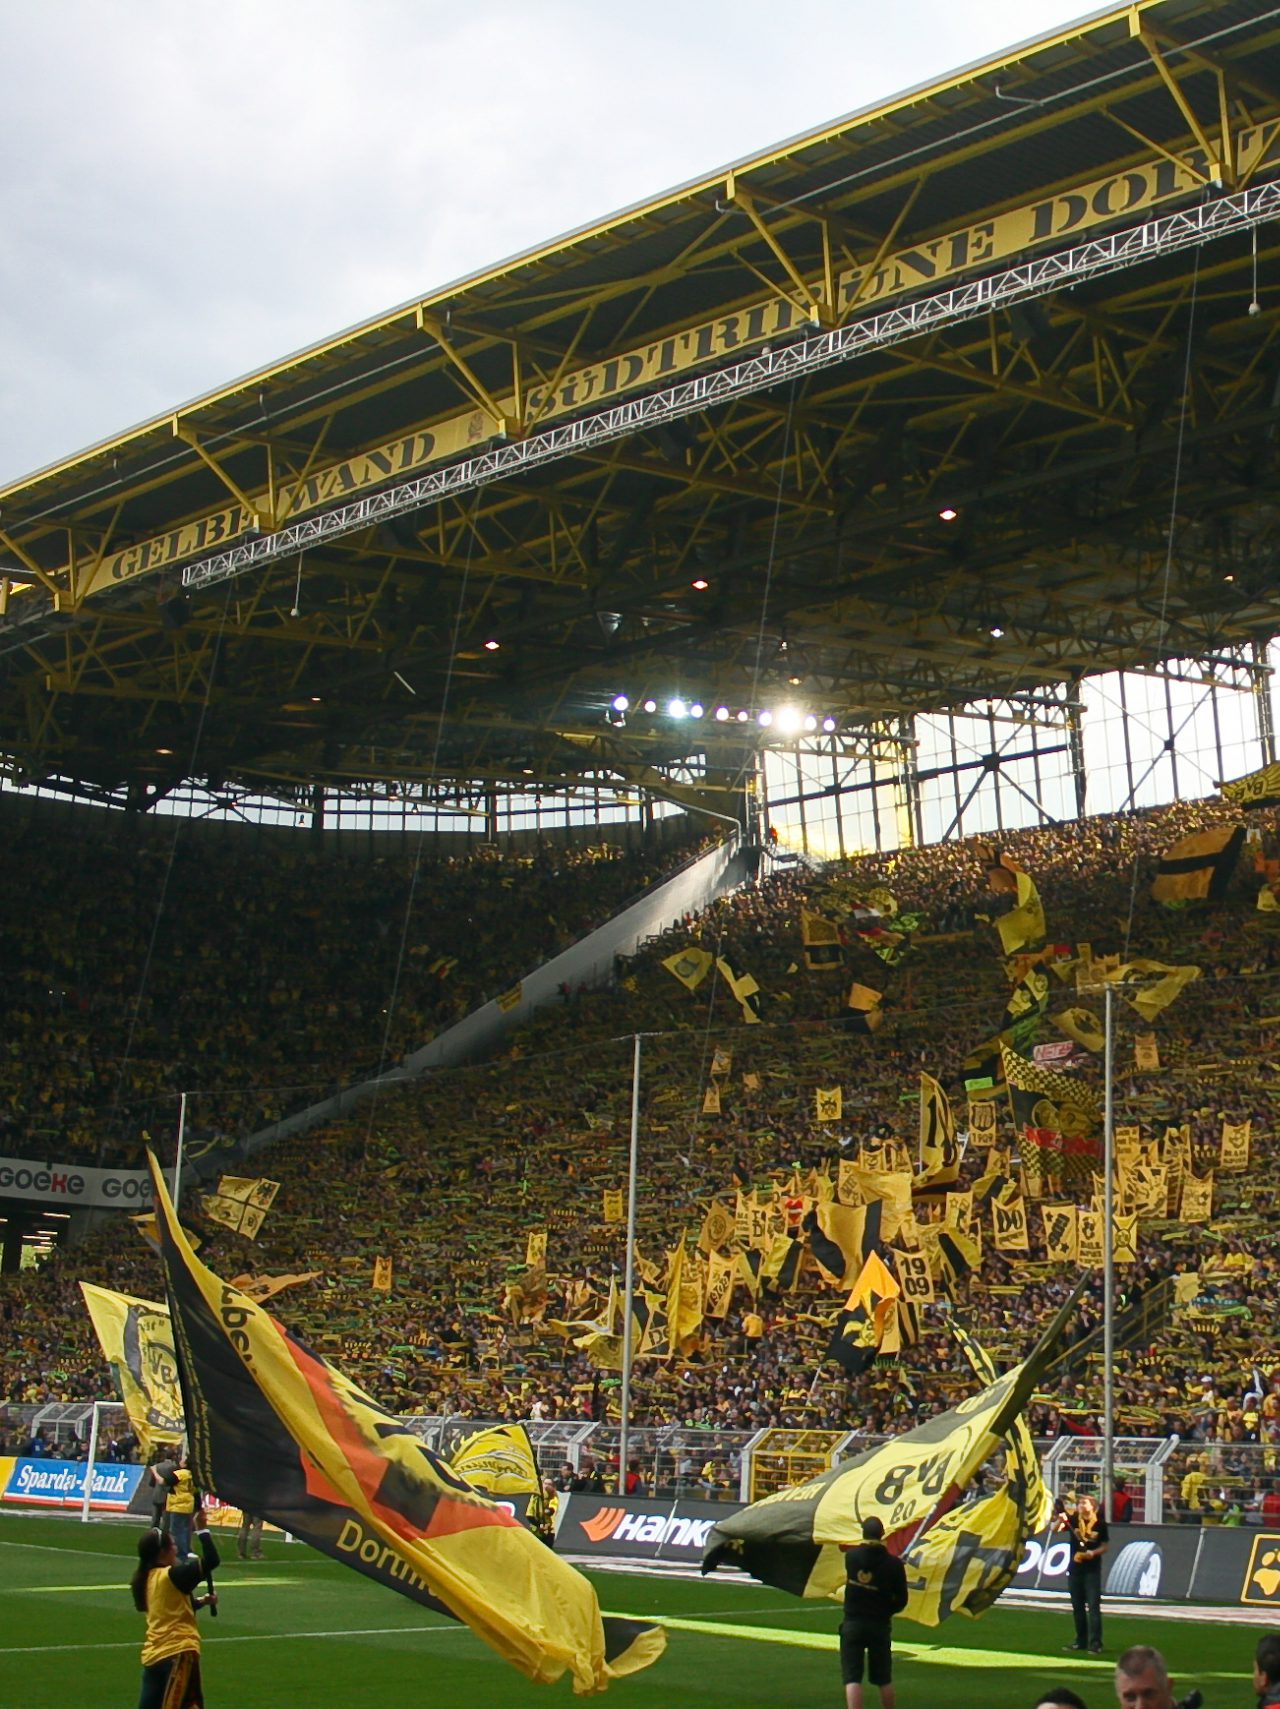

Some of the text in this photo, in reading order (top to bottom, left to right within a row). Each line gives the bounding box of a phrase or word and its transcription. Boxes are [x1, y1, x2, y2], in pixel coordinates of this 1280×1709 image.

[112, 502, 255, 579] GELBE
[285, 432, 436, 513] WAND
[901, 1256, 926, 1275] 19
[904, 1275, 929, 1297] 09
